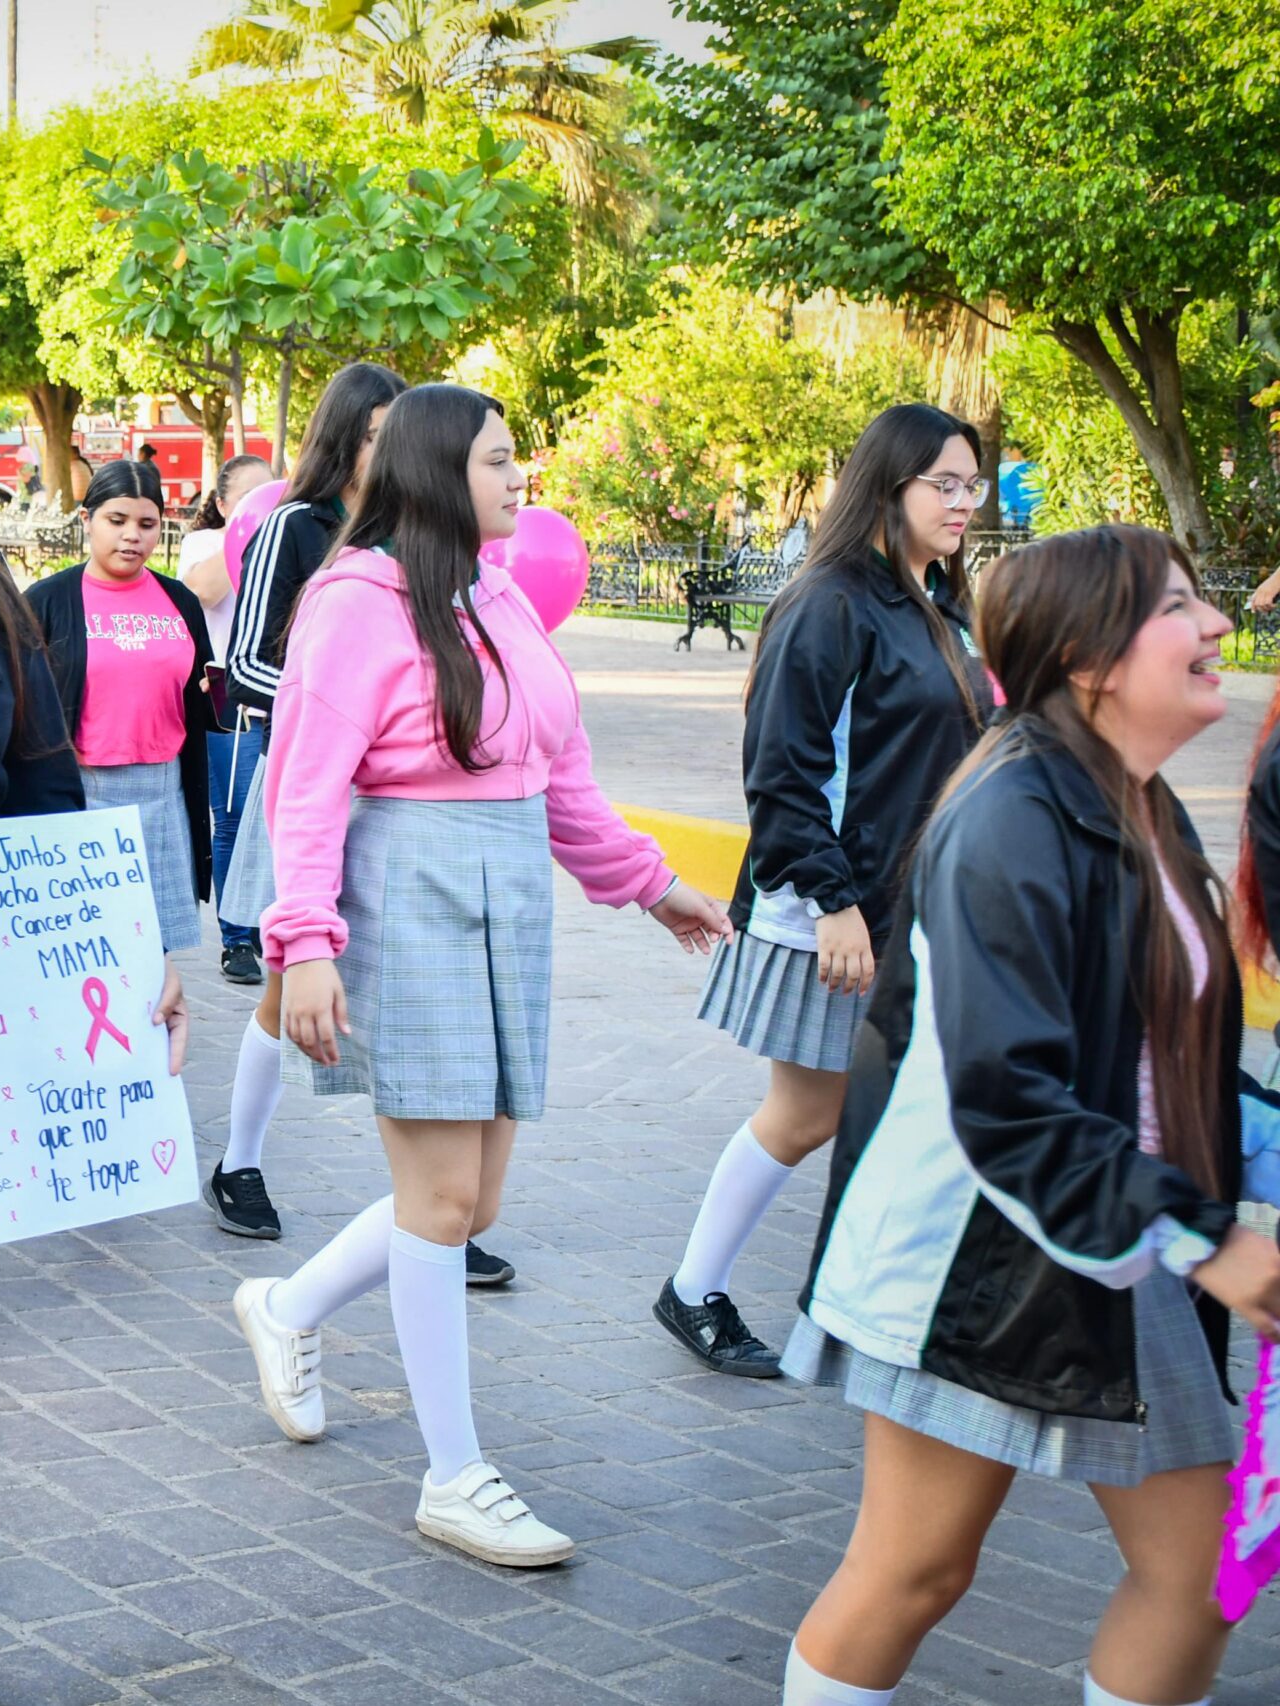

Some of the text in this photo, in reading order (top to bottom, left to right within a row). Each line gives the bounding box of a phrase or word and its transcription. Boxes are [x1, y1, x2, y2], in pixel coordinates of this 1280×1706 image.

[78, 840, 105, 860] en
[114, 827, 137, 855] la
[126, 858, 145, 884] el
[78, 899, 103, 923] de
[37, 935, 120, 979] MAMA
[119, 1079, 154, 1119] para
[38, 1118, 108, 1160] que no
[46, 1158, 141, 1203] te toque
